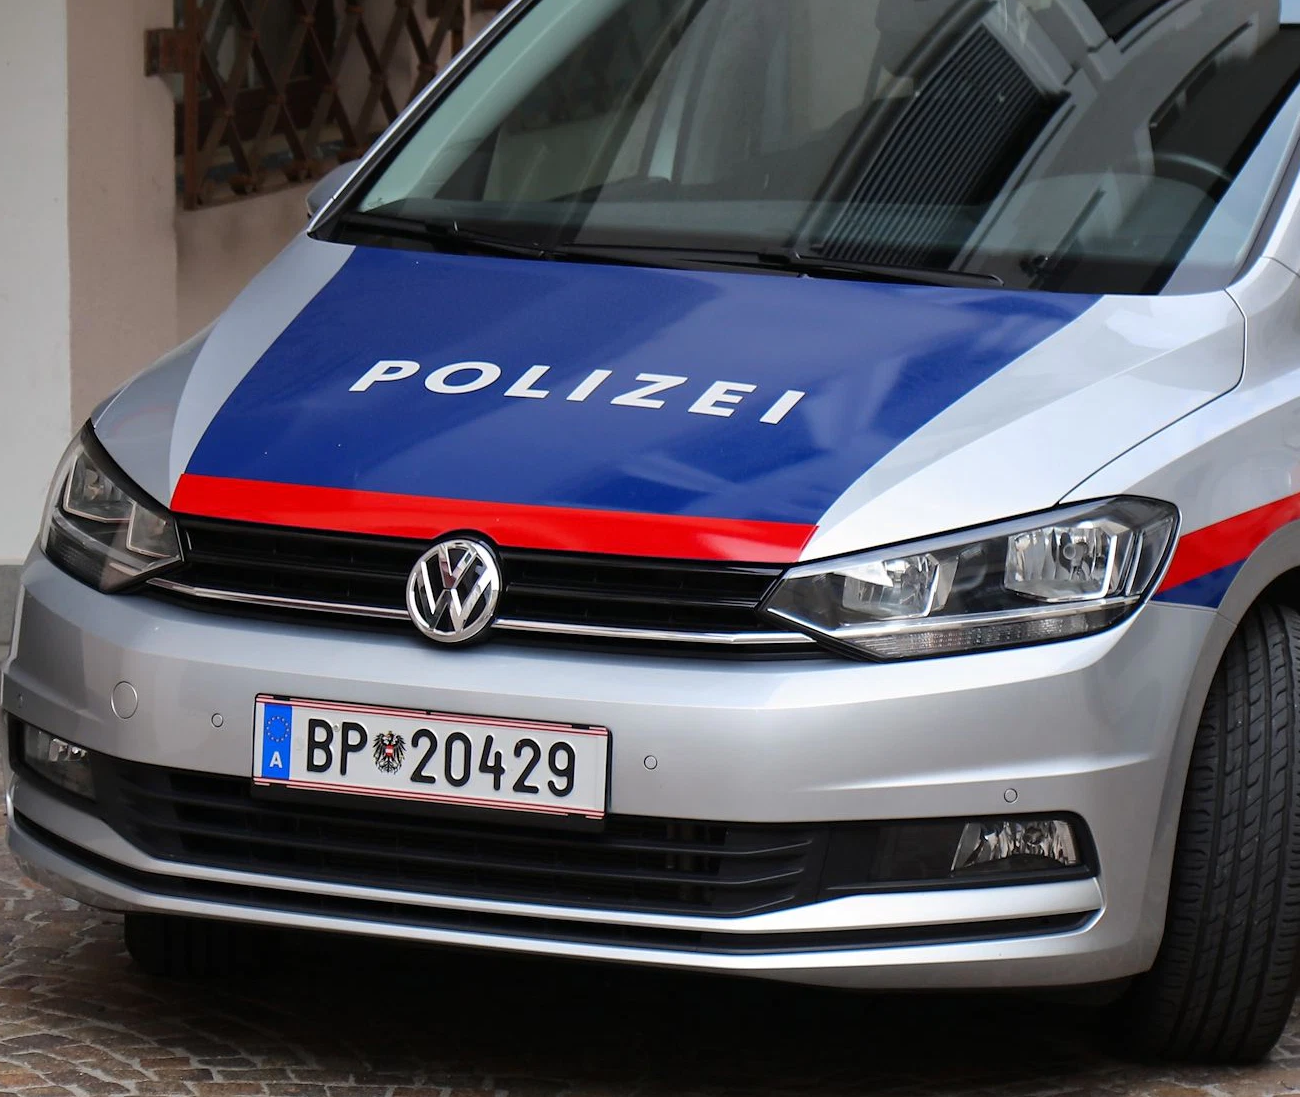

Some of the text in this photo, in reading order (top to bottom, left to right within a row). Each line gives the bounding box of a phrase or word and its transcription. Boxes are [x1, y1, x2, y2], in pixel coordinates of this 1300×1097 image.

[350, 360, 805, 424] POLIZEI
[406, 538, 500, 643] VW
[269, 717, 576, 797] A BP 20429
